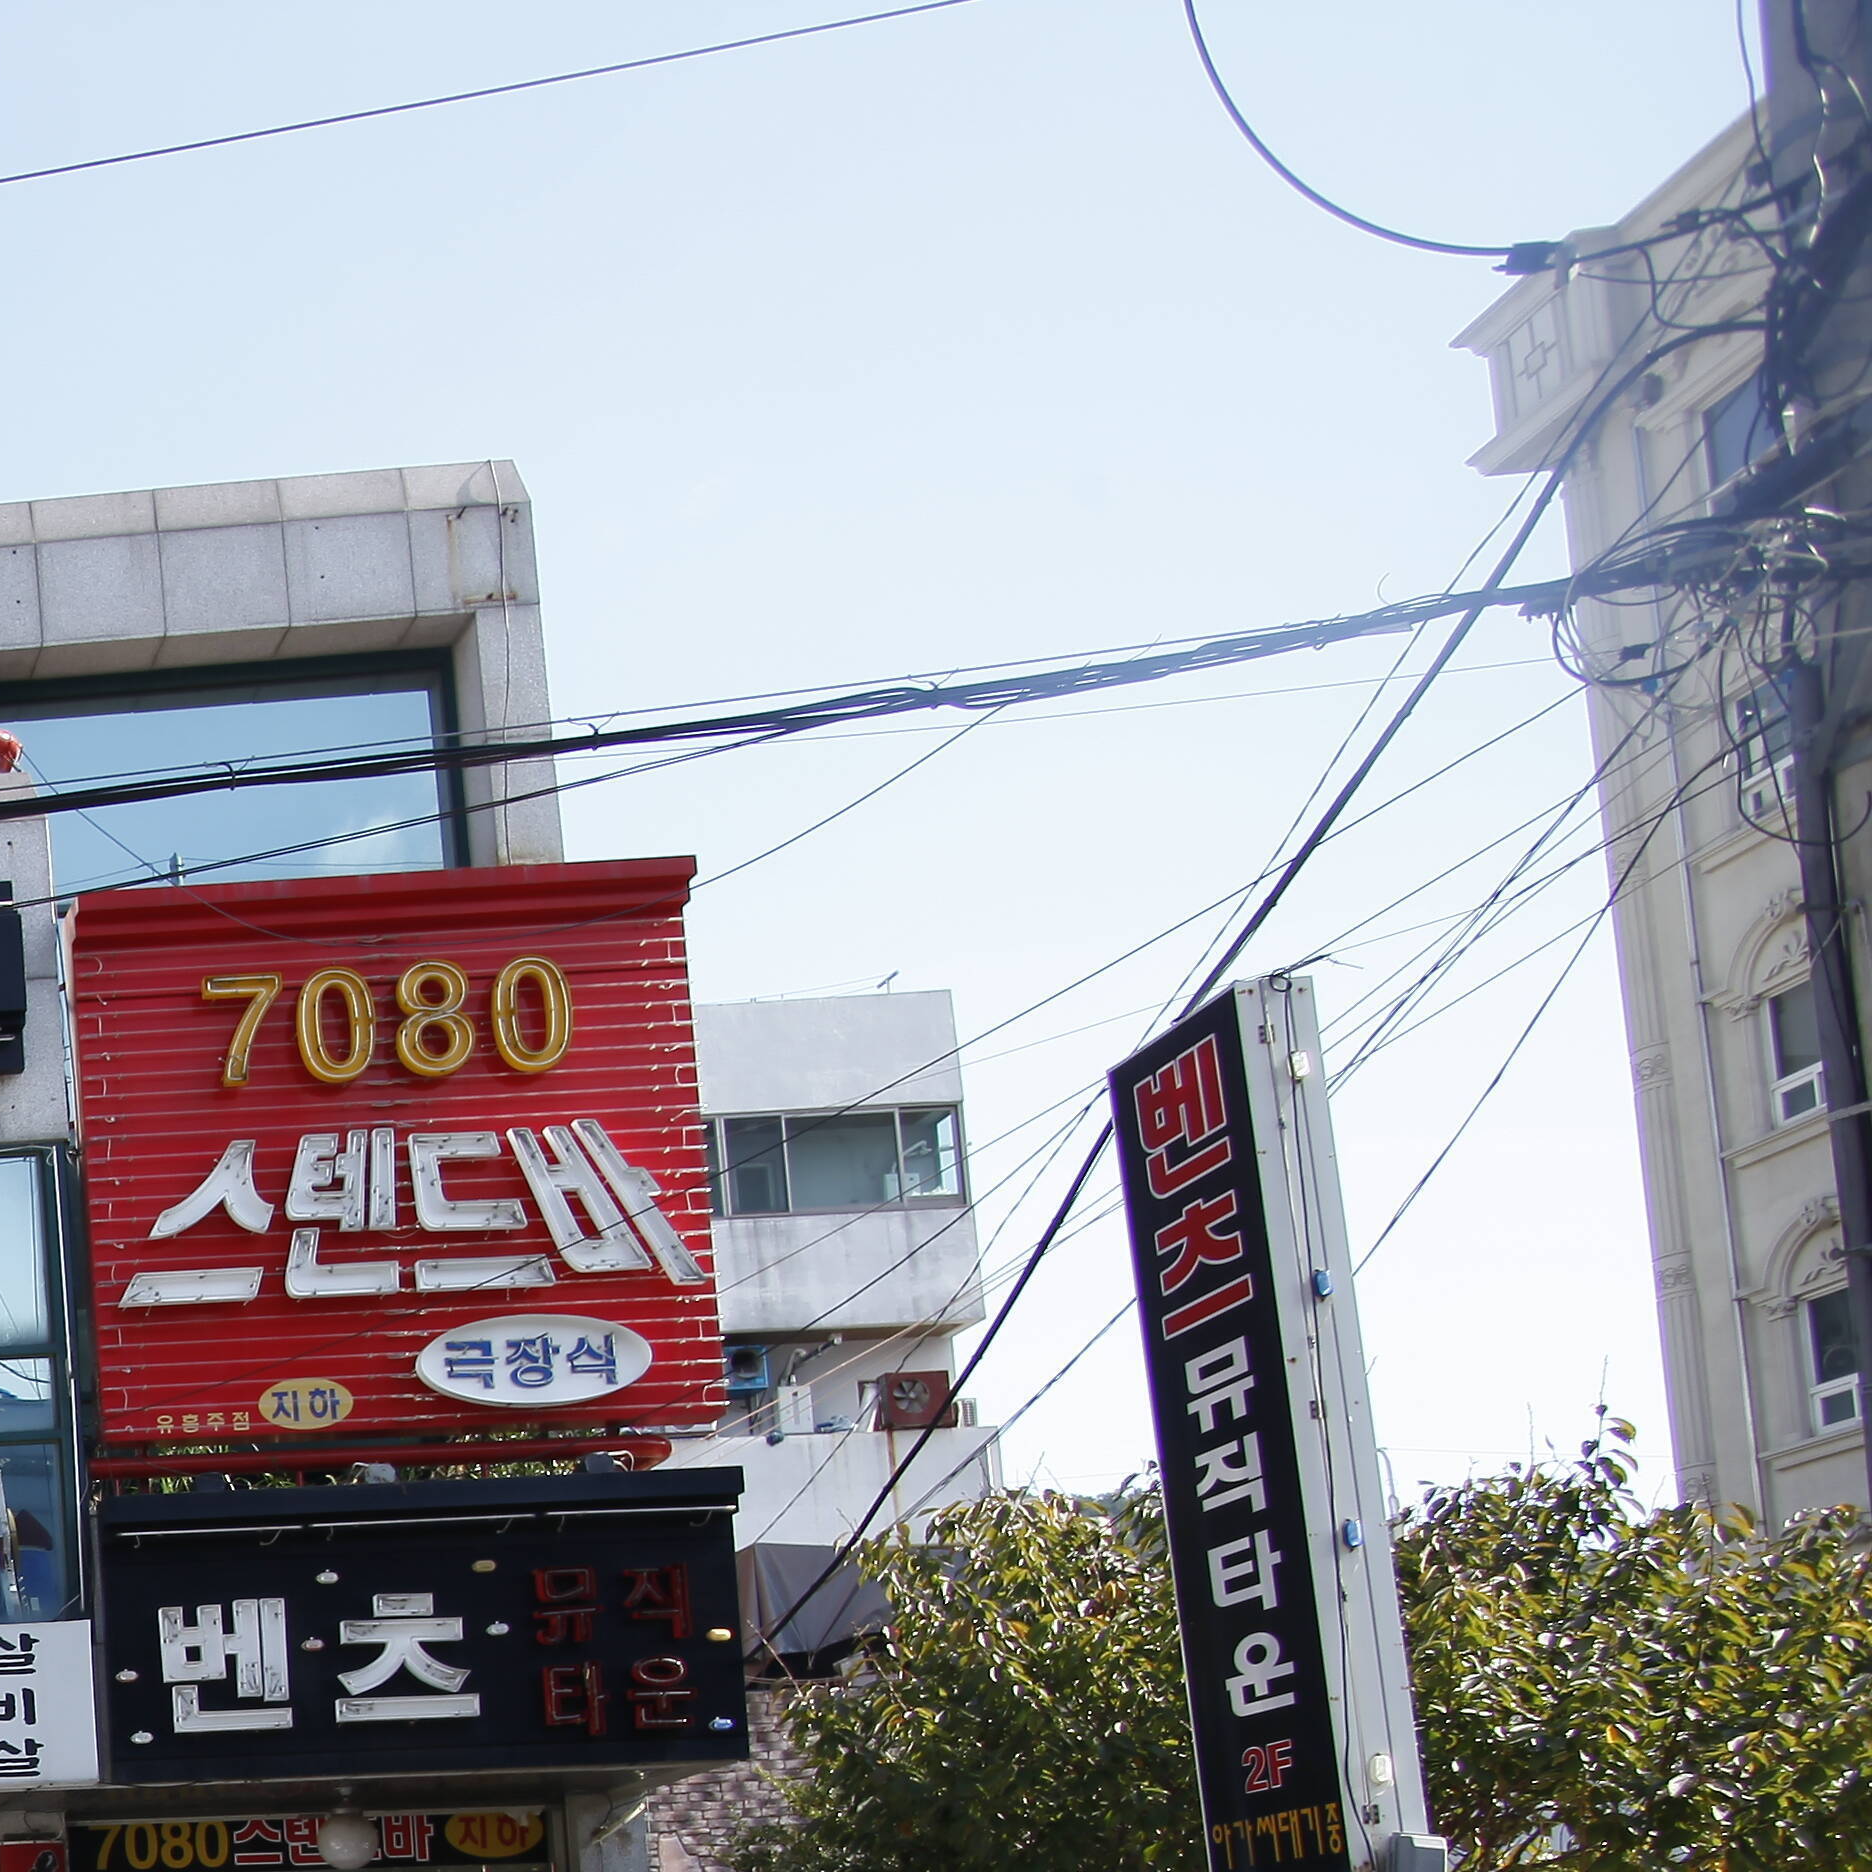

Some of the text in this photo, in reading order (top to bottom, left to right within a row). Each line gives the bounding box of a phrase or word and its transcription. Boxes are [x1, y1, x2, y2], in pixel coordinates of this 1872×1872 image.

[202, 955, 574, 1087] 7080
[118, 1118, 707, 1309] 스텐드바
[444, 1333, 618, 1390] 극장식
[156, 1411, 251, 1436] 유흥주점
[271, 1388, 345, 1422] 지하
[1185, 1336, 1296, 1718] 뮤직타운
[532, 1563, 694, 1645] 뮤직
[158, 1592, 482, 1734] 벤츠
[543, 1656, 699, 1737] 타운
[1240, 1739, 1294, 1794] 2F
[88, 1812, 435, 1871] 7080 스텐바
